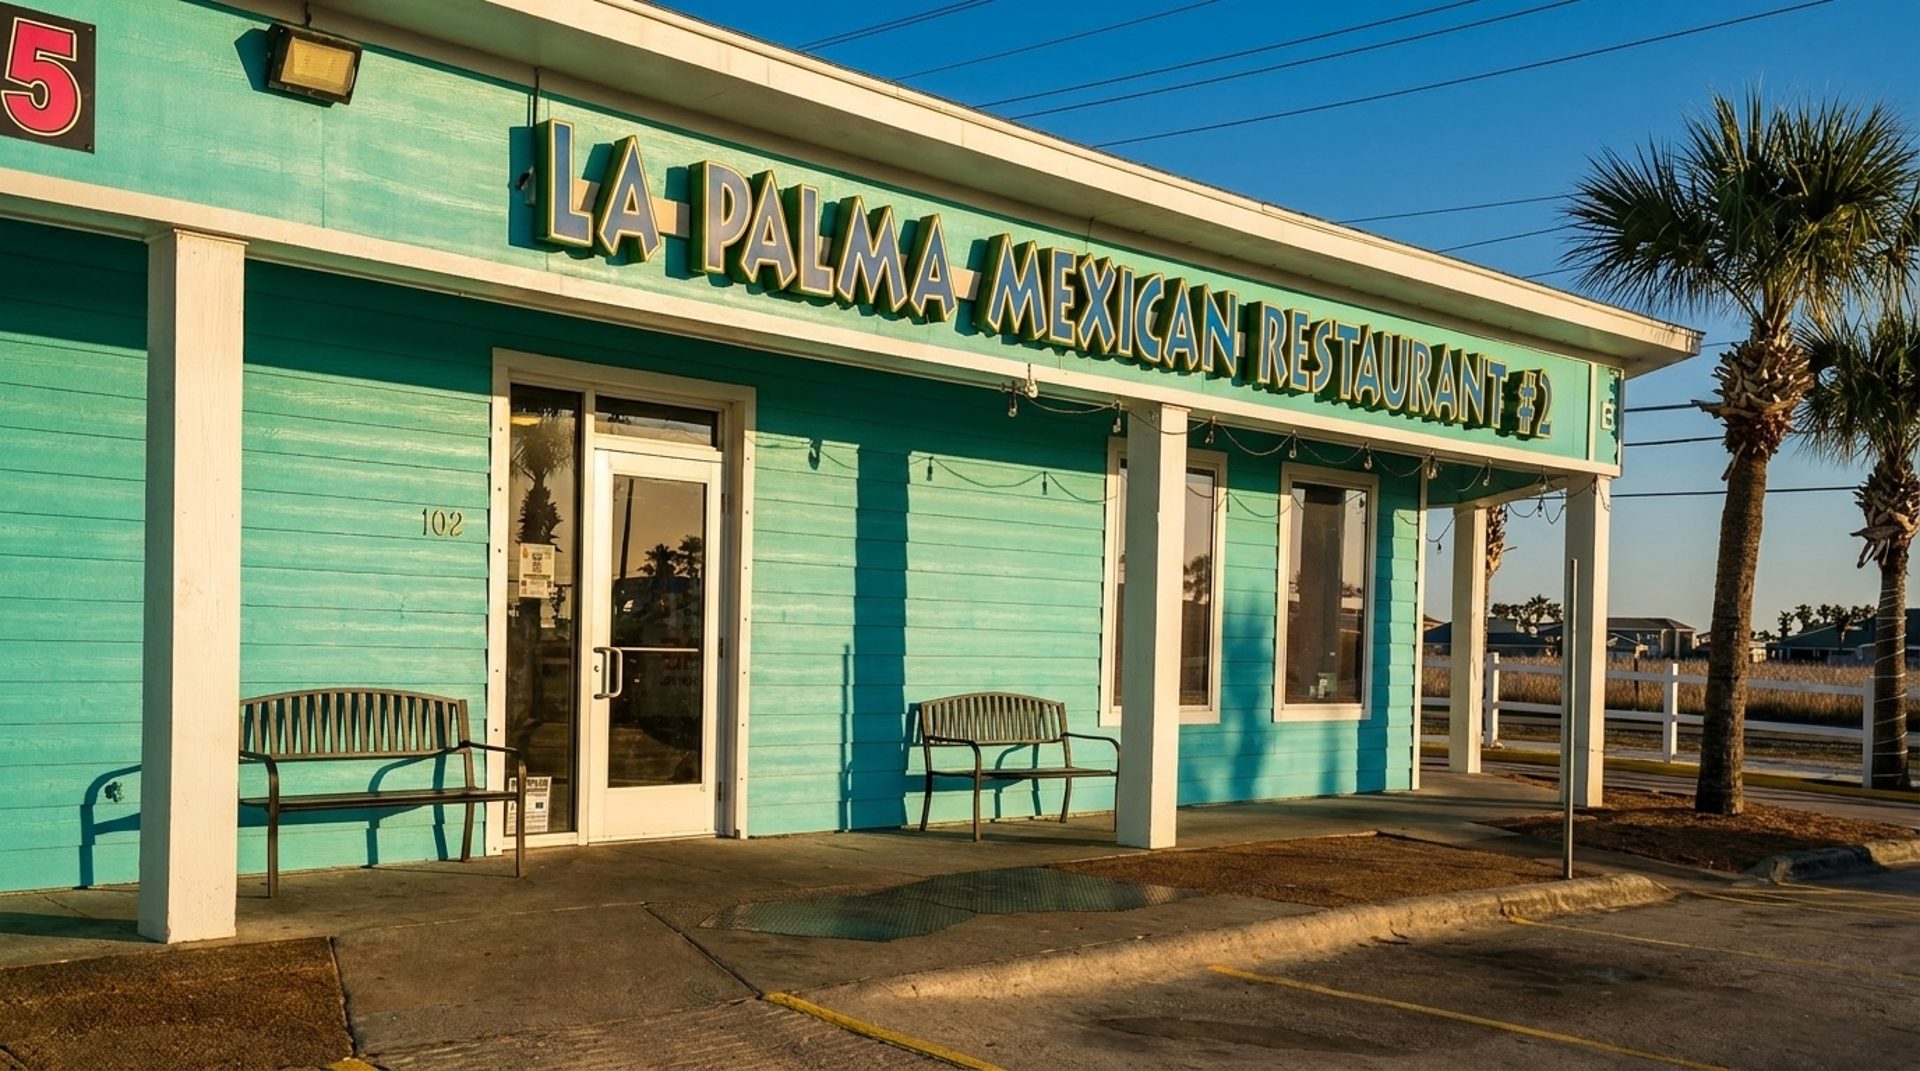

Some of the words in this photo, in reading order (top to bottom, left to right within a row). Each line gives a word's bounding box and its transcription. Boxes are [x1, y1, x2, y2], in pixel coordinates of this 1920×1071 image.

[0, 17, 82, 137] 5
[543, 118, 662, 263] LA
[696, 159, 958, 323] PALMA
[983, 232, 1240, 377] MEXICAN
[1256, 300, 1508, 428] RESTAURANT
[1516, 367, 1554, 439] #2
[422, 508, 463, 537] 102
